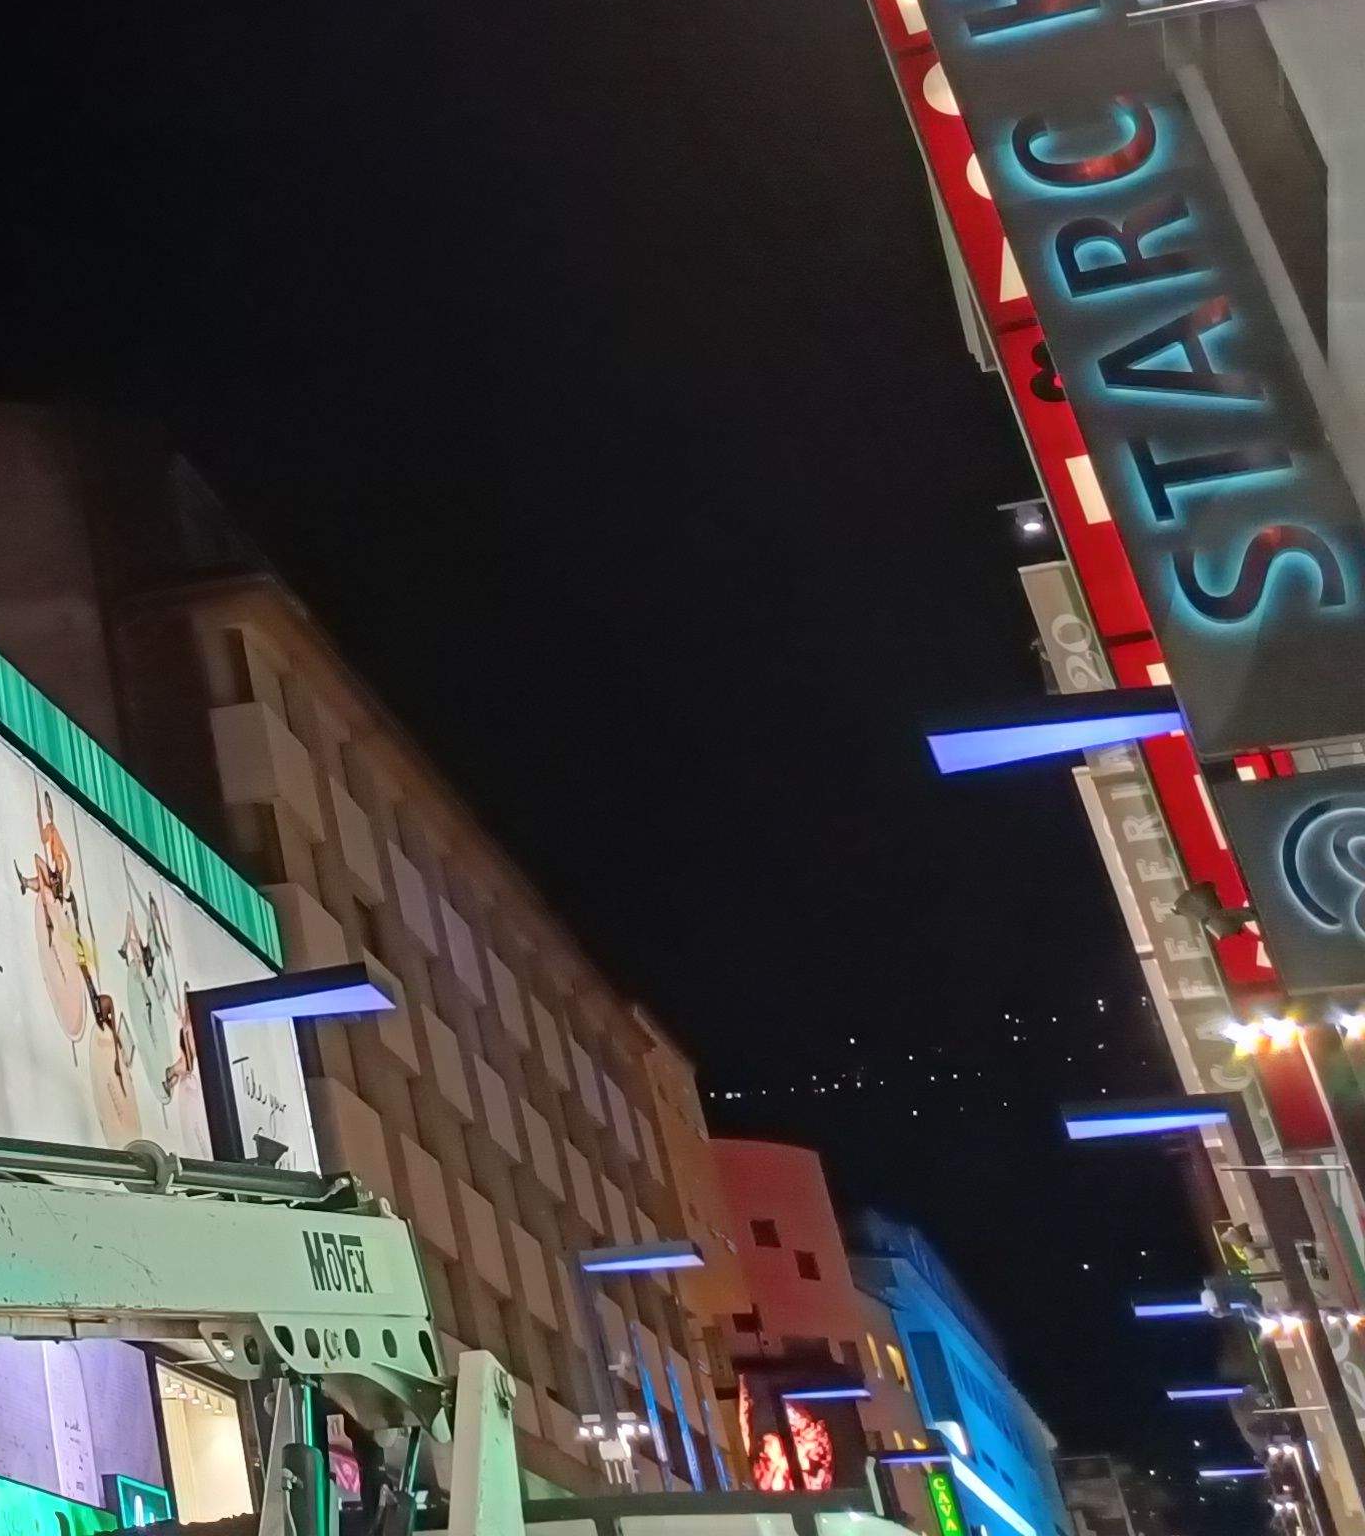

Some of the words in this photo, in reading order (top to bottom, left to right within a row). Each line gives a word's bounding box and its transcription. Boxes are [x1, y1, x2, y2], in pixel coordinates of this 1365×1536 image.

[1010, 97, 1347, 622] STARC
[302, 1230, 374, 1294] MOVEX
[932, 1477, 958, 1531] CAVA
